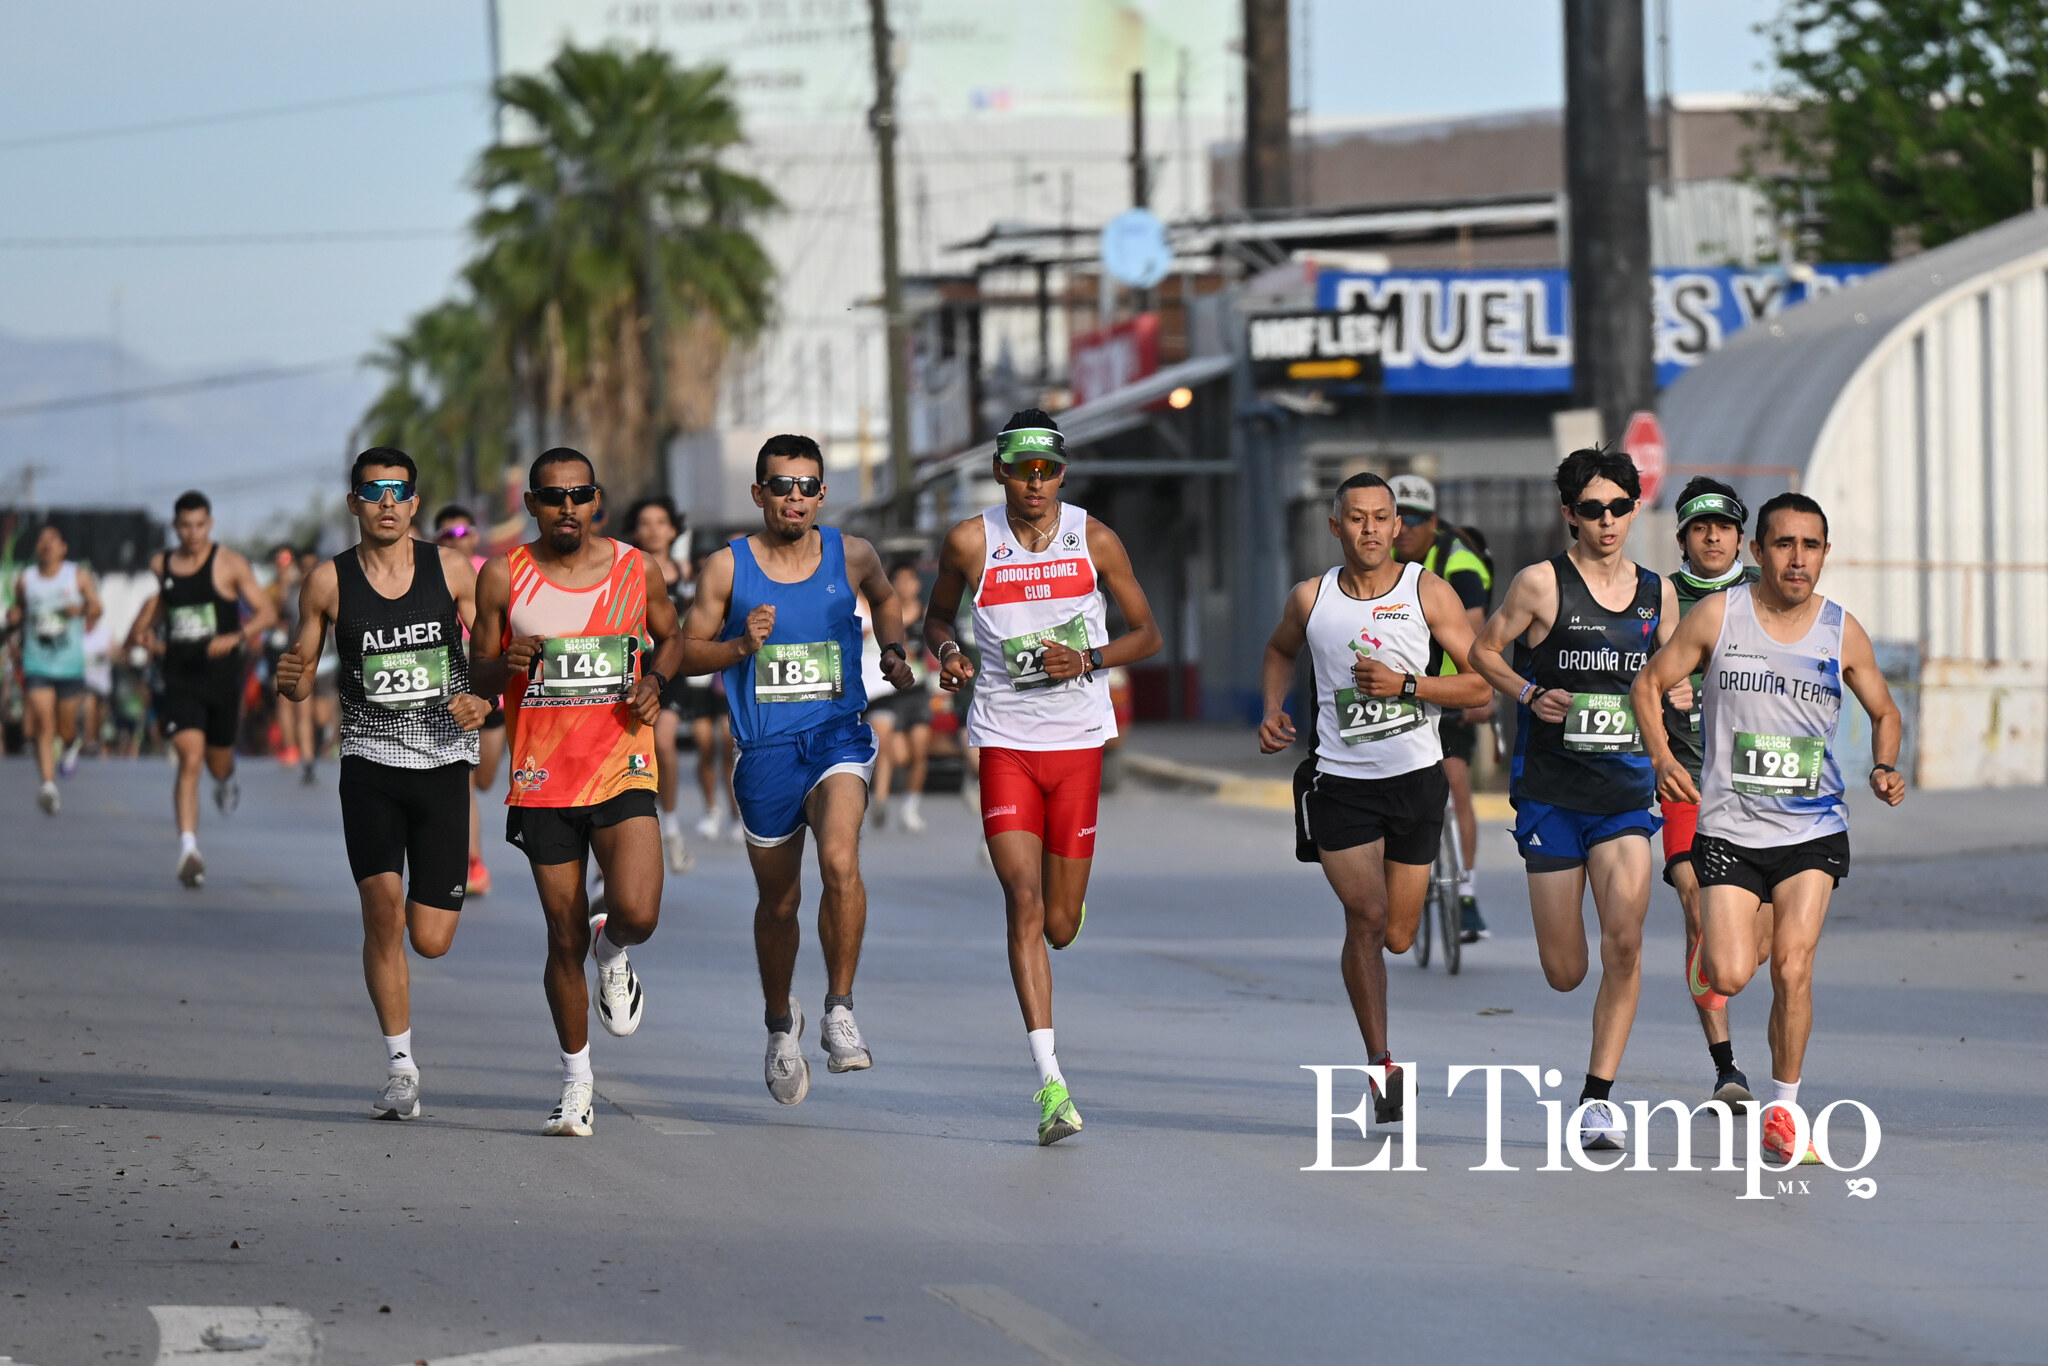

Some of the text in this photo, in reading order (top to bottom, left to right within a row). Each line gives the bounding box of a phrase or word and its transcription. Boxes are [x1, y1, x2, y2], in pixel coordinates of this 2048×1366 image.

[1251, 315, 1379, 360] MOFLES
[996, 562, 1078, 584] RODOLFO GÓMEZ
[1024, 584, 1051, 600] CLUB
[362, 621, 441, 651] ALHER
[556, 653, 611, 678] 146
[768, 659, 820, 684] 185
[833, 654, 842, 692] MEDALLA
[1559, 648, 1648, 672] ORDUÑA TEA
[374, 667, 430, 694] 238
[1719, 670, 1833, 706] ORDUÑA TEAM
[544, 698, 572, 707] NORA
[572, 696, 610, 706] LETICIA
[1346, 696, 1402, 727] 295
[1578, 710, 1627, 734] 199
[1745, 750, 1800, 778] 198
[1809, 751, 1820, 790] MEDALLA
